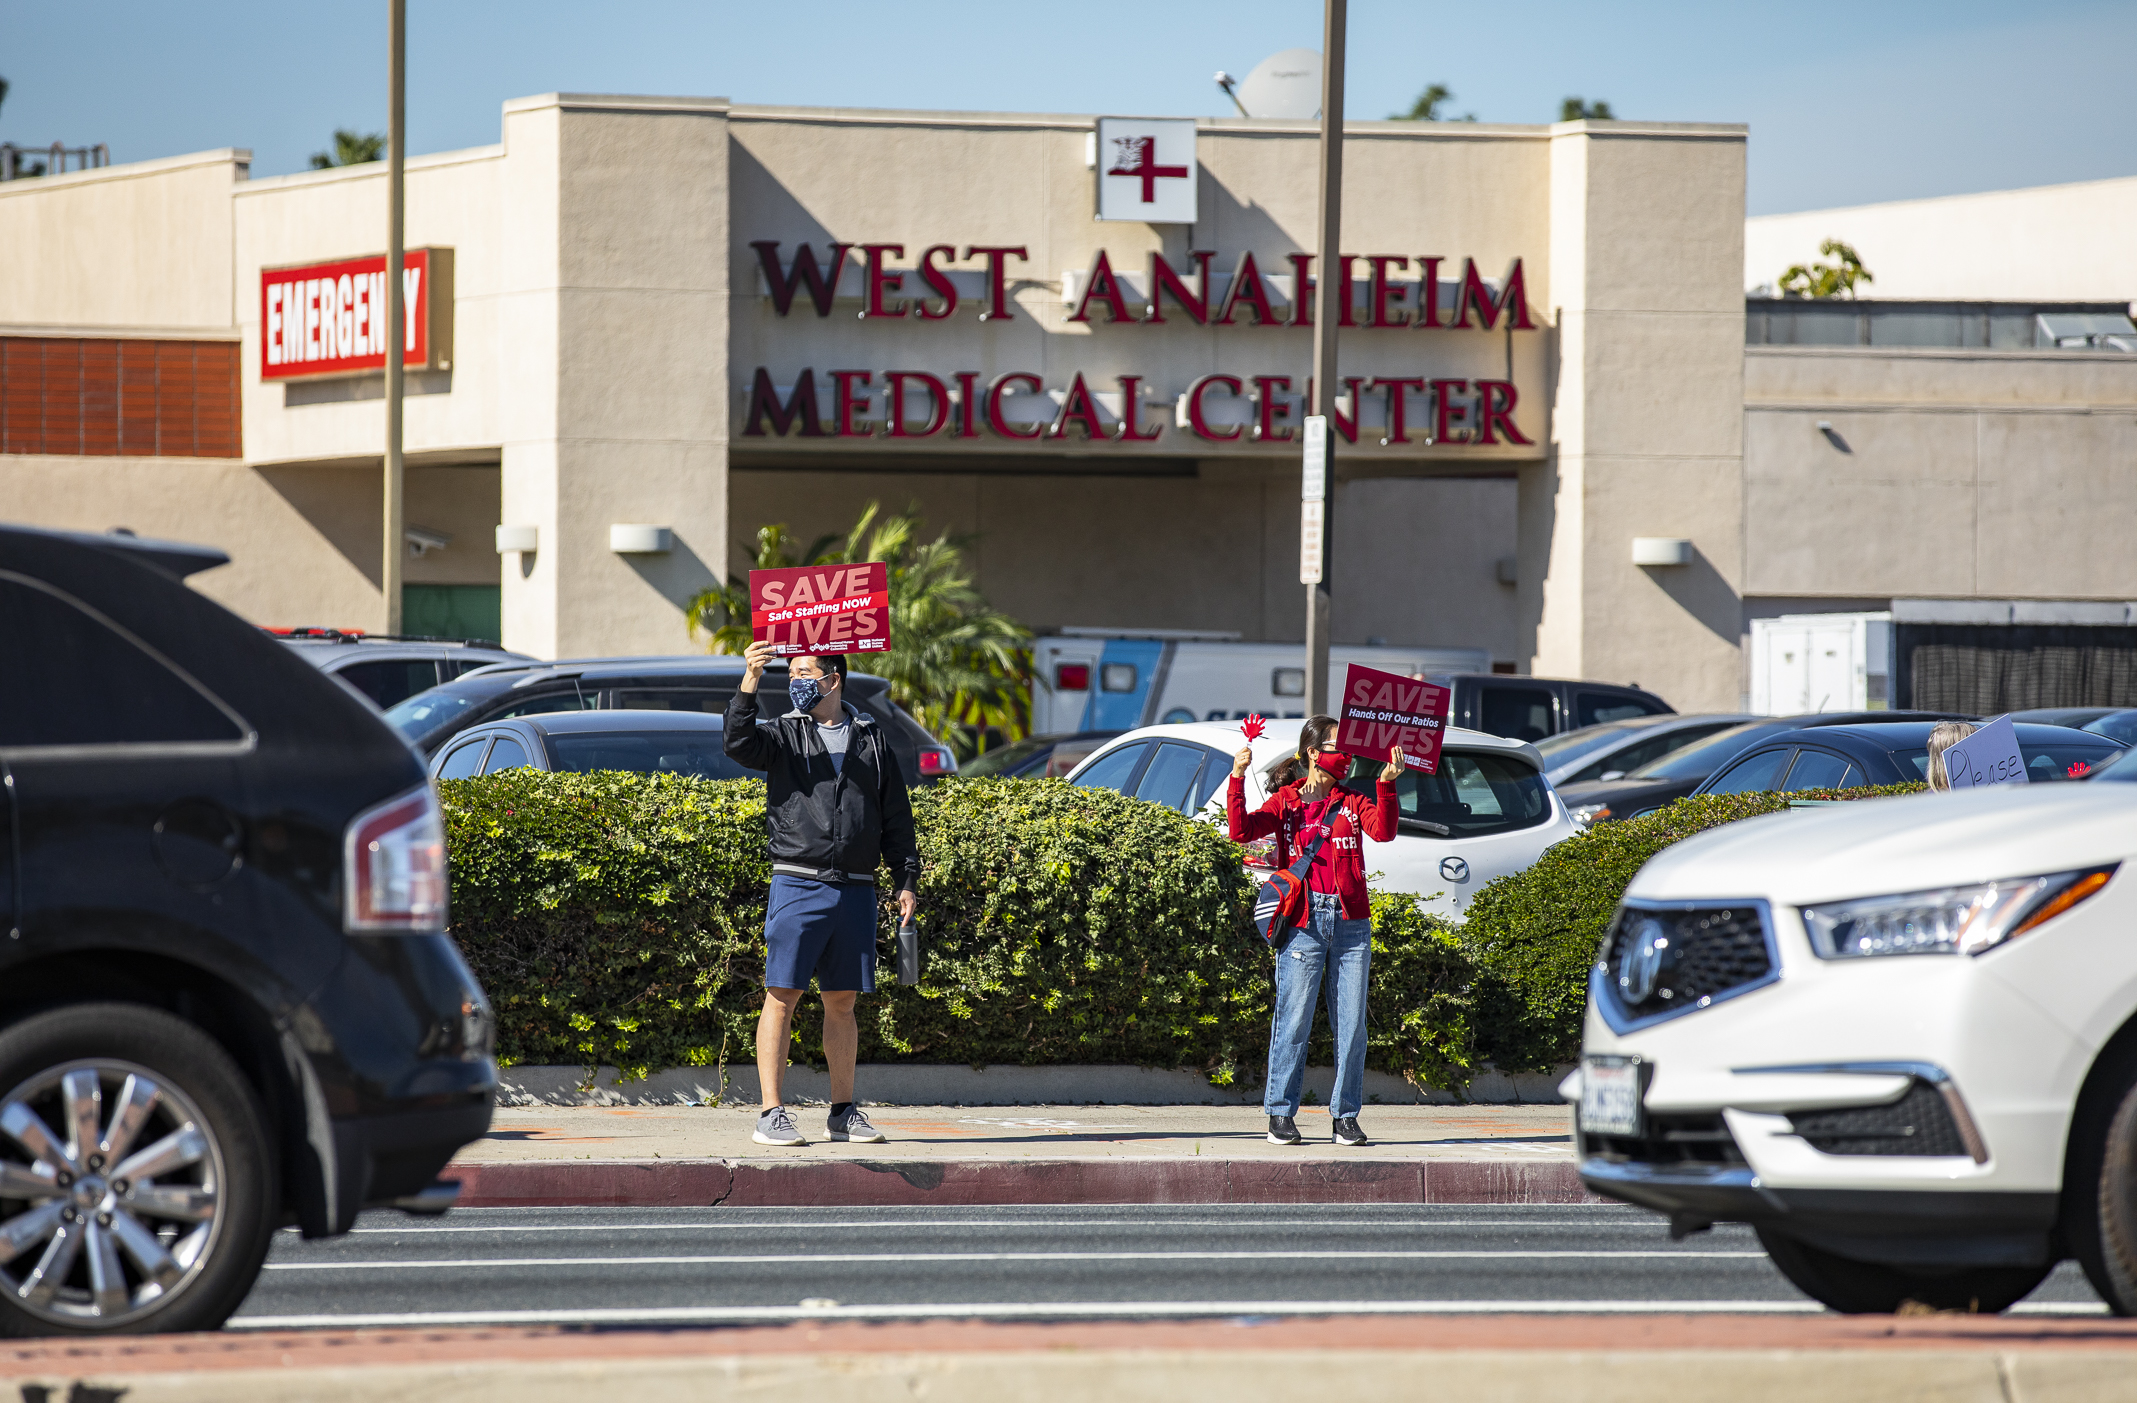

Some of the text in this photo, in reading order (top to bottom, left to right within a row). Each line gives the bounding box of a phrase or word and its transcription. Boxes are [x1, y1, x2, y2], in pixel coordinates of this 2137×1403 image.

[749, 240, 1538, 331] WEST ANAHEIM
[266, 266, 421, 366] EMERGENY
[741, 366, 1163, 441] MEDICAL
[759, 565, 872, 611] SAVE
[766, 607, 878, 646] LIVES
[768, 596, 872, 622] Safe Staffing NOW
[1349, 679, 1440, 715] SAVE
[1348, 707, 1439, 728] Hands Off Our Ratios
[1344, 720, 1437, 755] LIVES
